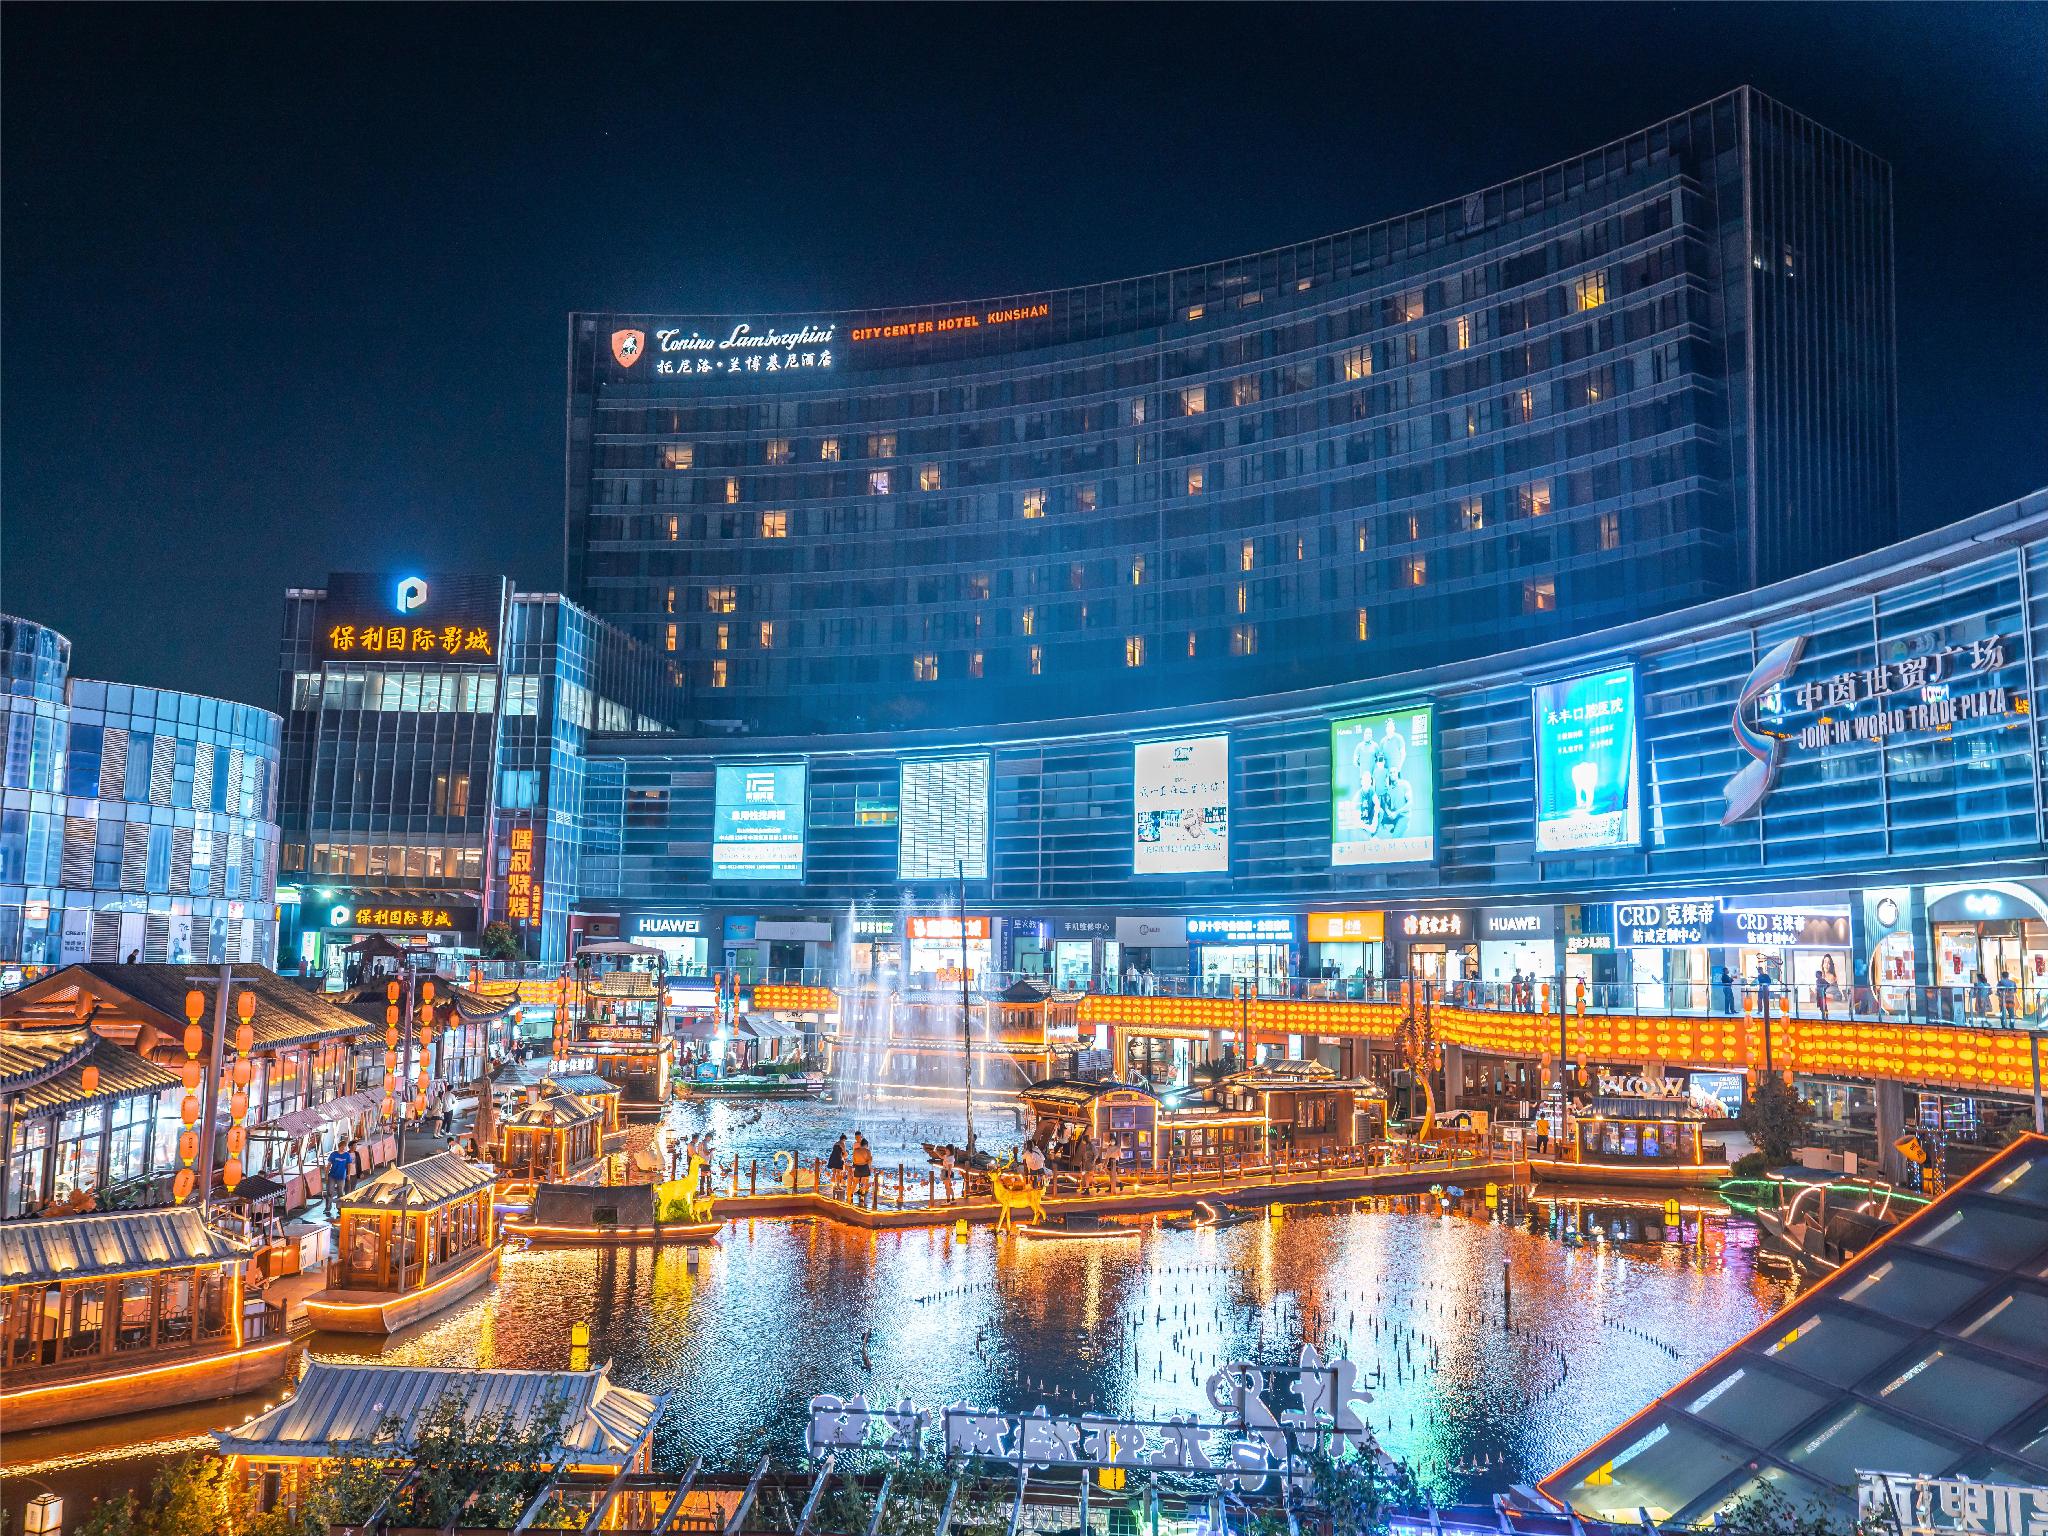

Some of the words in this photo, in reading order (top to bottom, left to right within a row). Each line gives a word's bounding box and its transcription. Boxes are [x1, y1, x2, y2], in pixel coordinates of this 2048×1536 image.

[852, 328, 881, 340] CITY
[883, 322, 933, 337] CENTER
[937, 316, 979, 331] HOTEL
[987, 304, 1048, 323] KUNSHAN
[656, 328, 715, 352] Tonino
[719, 324, 836, 350] Lamborghini
[656, 350, 832, 374] 托尼洛·兰博基尼酒店
[329, 625, 493, 656] 保利国际影城
[1797, 634, 2004, 711] 中茵世贸广场
[1854, 708, 1906, 738] WORLD
[1910, 699, 1958, 729] TRADE
[1961, 687, 2007, 720] PLAZA
[508, 829, 531, 918] 嘿叔烧烤
[355, 907, 452, 927] 保利国际影城
[639, 919, 700, 932] HUAWEI
[1014, 919, 1042, 928] 星火教
[1064, 921, 1110, 931] 手机维修中心
[1489, 916, 1541, 931] HUAWEI
[1619, 905, 1660, 926] CRD
[1736, 913, 1768, 930] CRD
